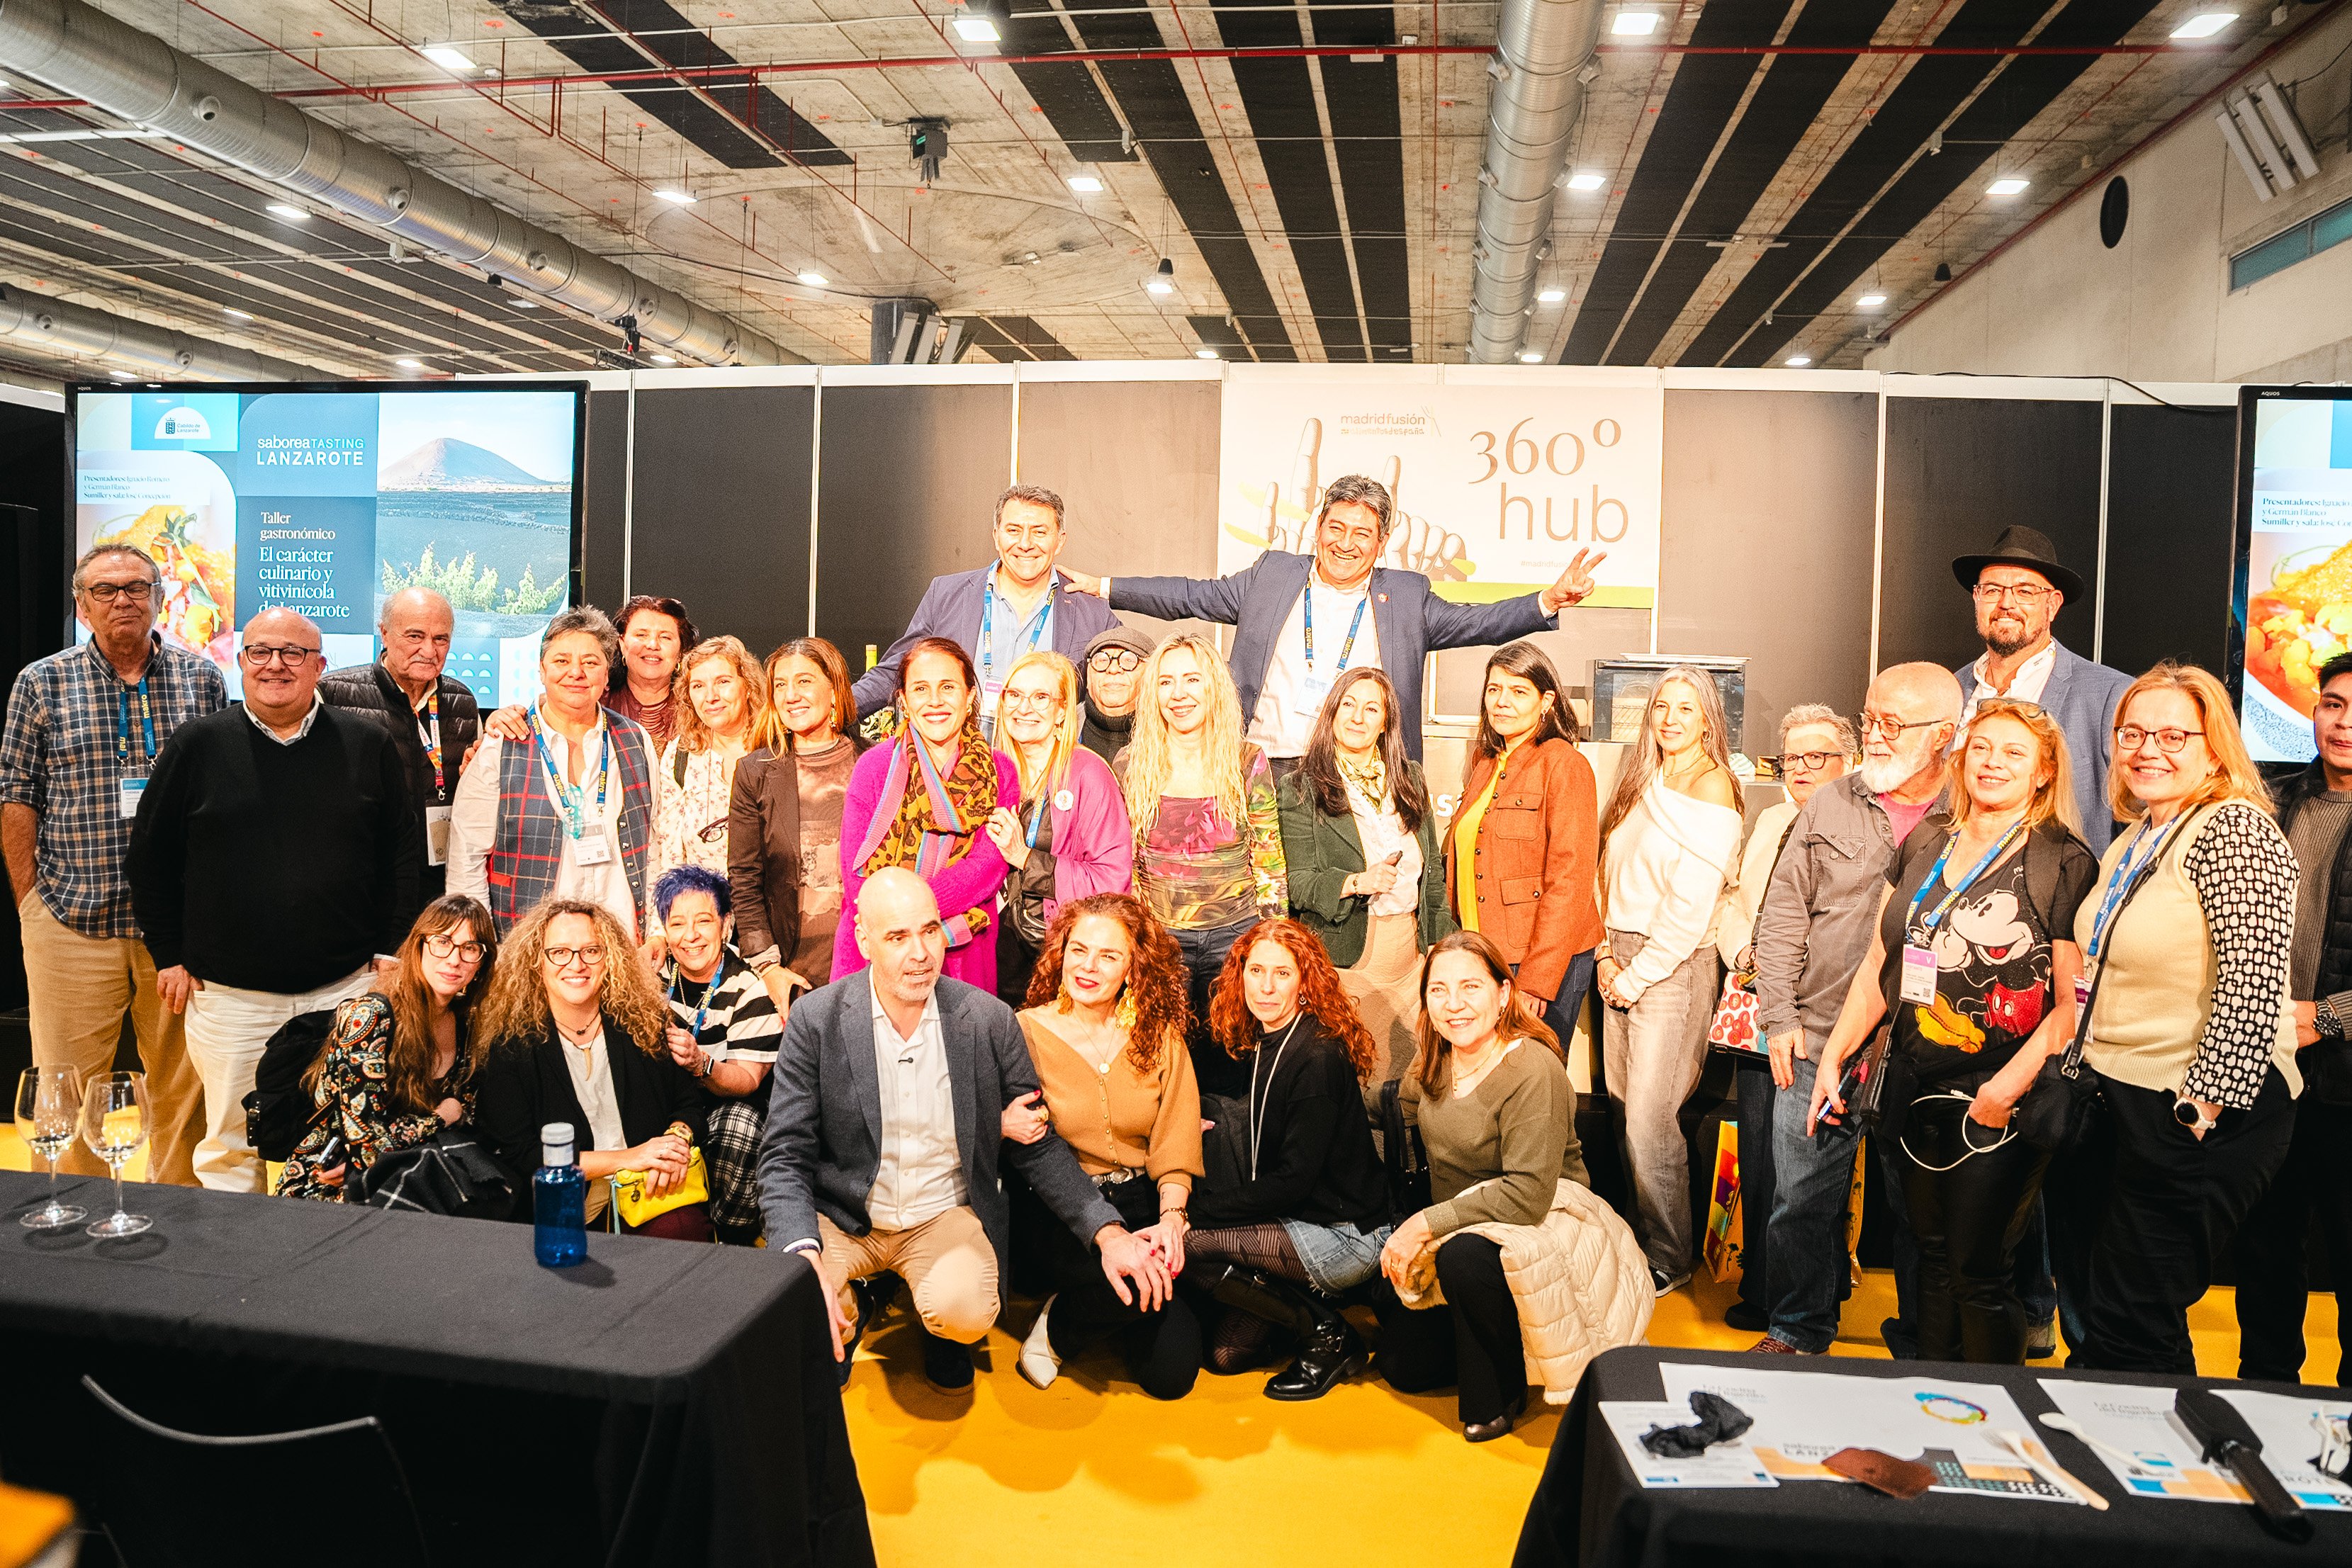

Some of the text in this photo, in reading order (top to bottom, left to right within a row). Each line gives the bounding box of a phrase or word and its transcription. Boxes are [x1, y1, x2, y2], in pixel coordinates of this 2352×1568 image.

[257, 434, 364, 449] saborea TASTING
[257, 451, 364, 466] LANZAROTE
[260, 512, 291, 524] Taller
[1499, 482, 1628, 543] hub
[259, 527, 336, 541] gastronómico
[259, 546, 334, 563] El carácter
[259, 565, 333, 584] culinario y
[258, 583, 335, 599] vitivinícola
[1341, 637, 1354, 659] makro
[141, 694, 150, 718] makro
[531, 714, 541, 735] makro
[553, 774, 566, 797] makro
[598, 770, 607, 793] makro
[1940, 835, 1957, 859] makro
[1936, 890, 1961, 915] makro
[670, 962, 679, 987] makro
[700, 986, 715, 1010] makro
